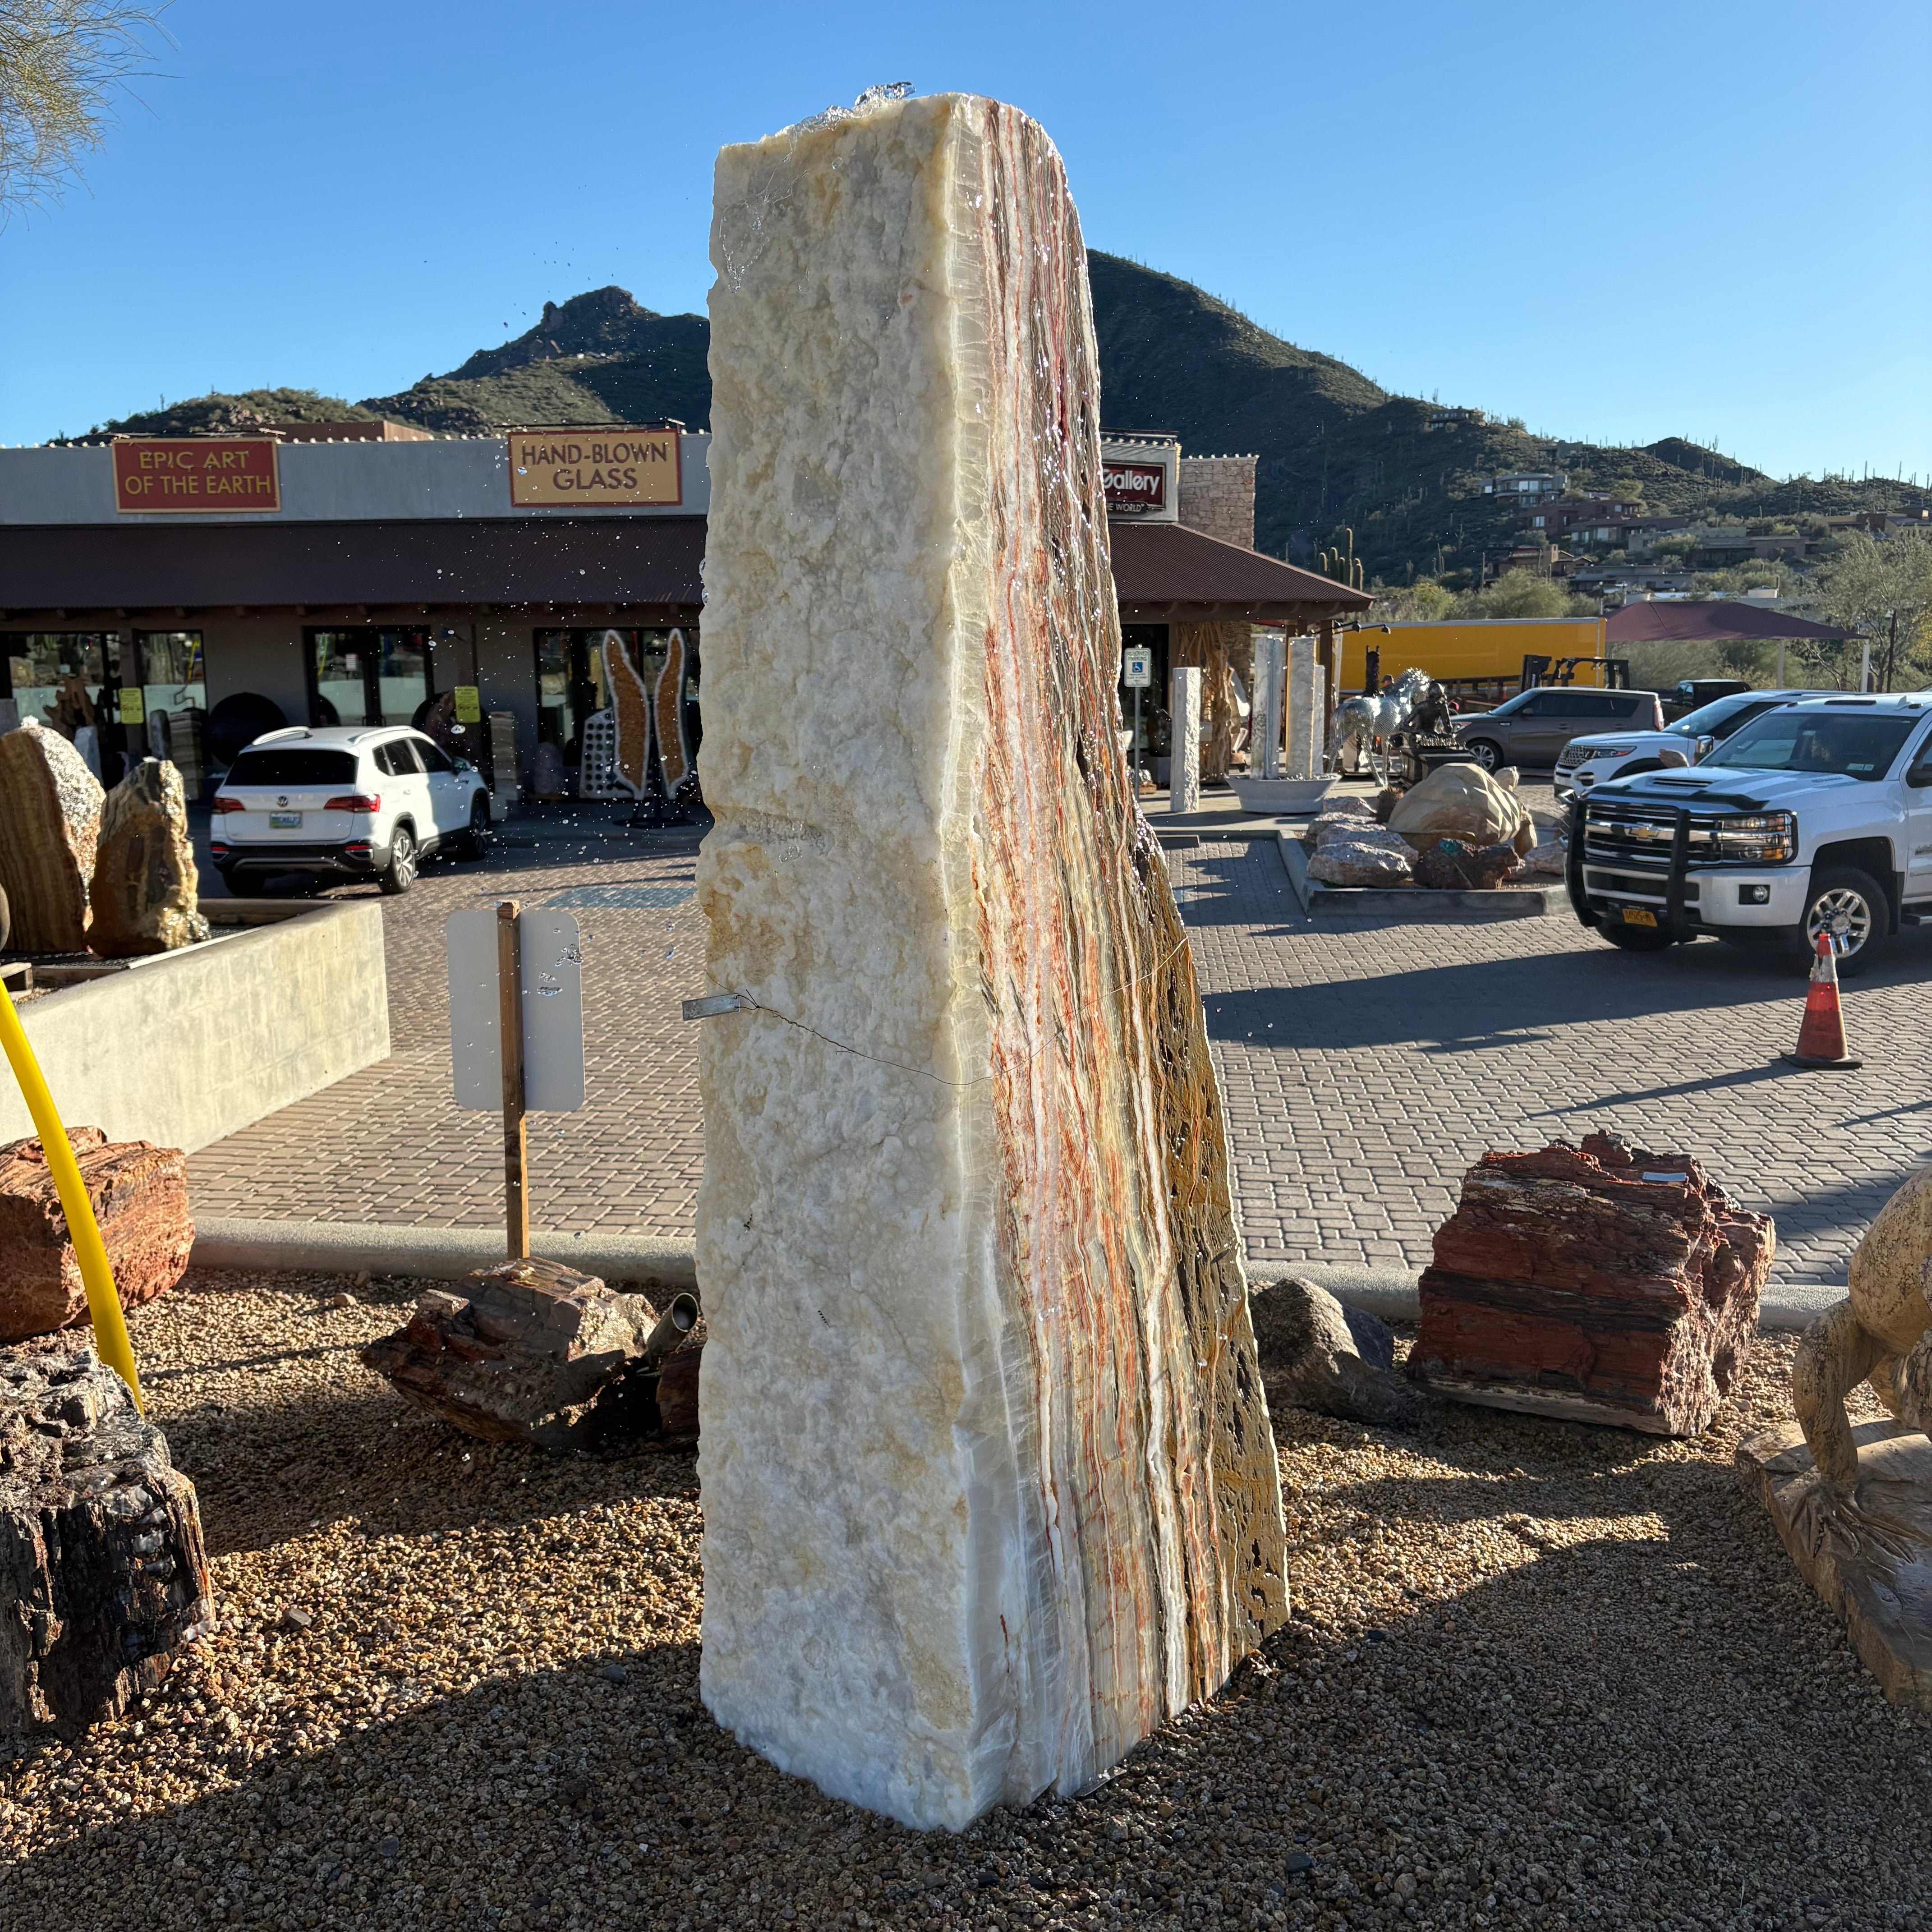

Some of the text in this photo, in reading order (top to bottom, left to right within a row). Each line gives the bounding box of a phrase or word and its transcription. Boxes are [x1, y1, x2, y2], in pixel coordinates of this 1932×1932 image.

[139, 451, 248, 469] EPIC ART
[522, 442, 667, 465] HAND-BLOWN
[124, 475, 271, 494] OF THE EARTH
[553, 468, 638, 490] GLASS
